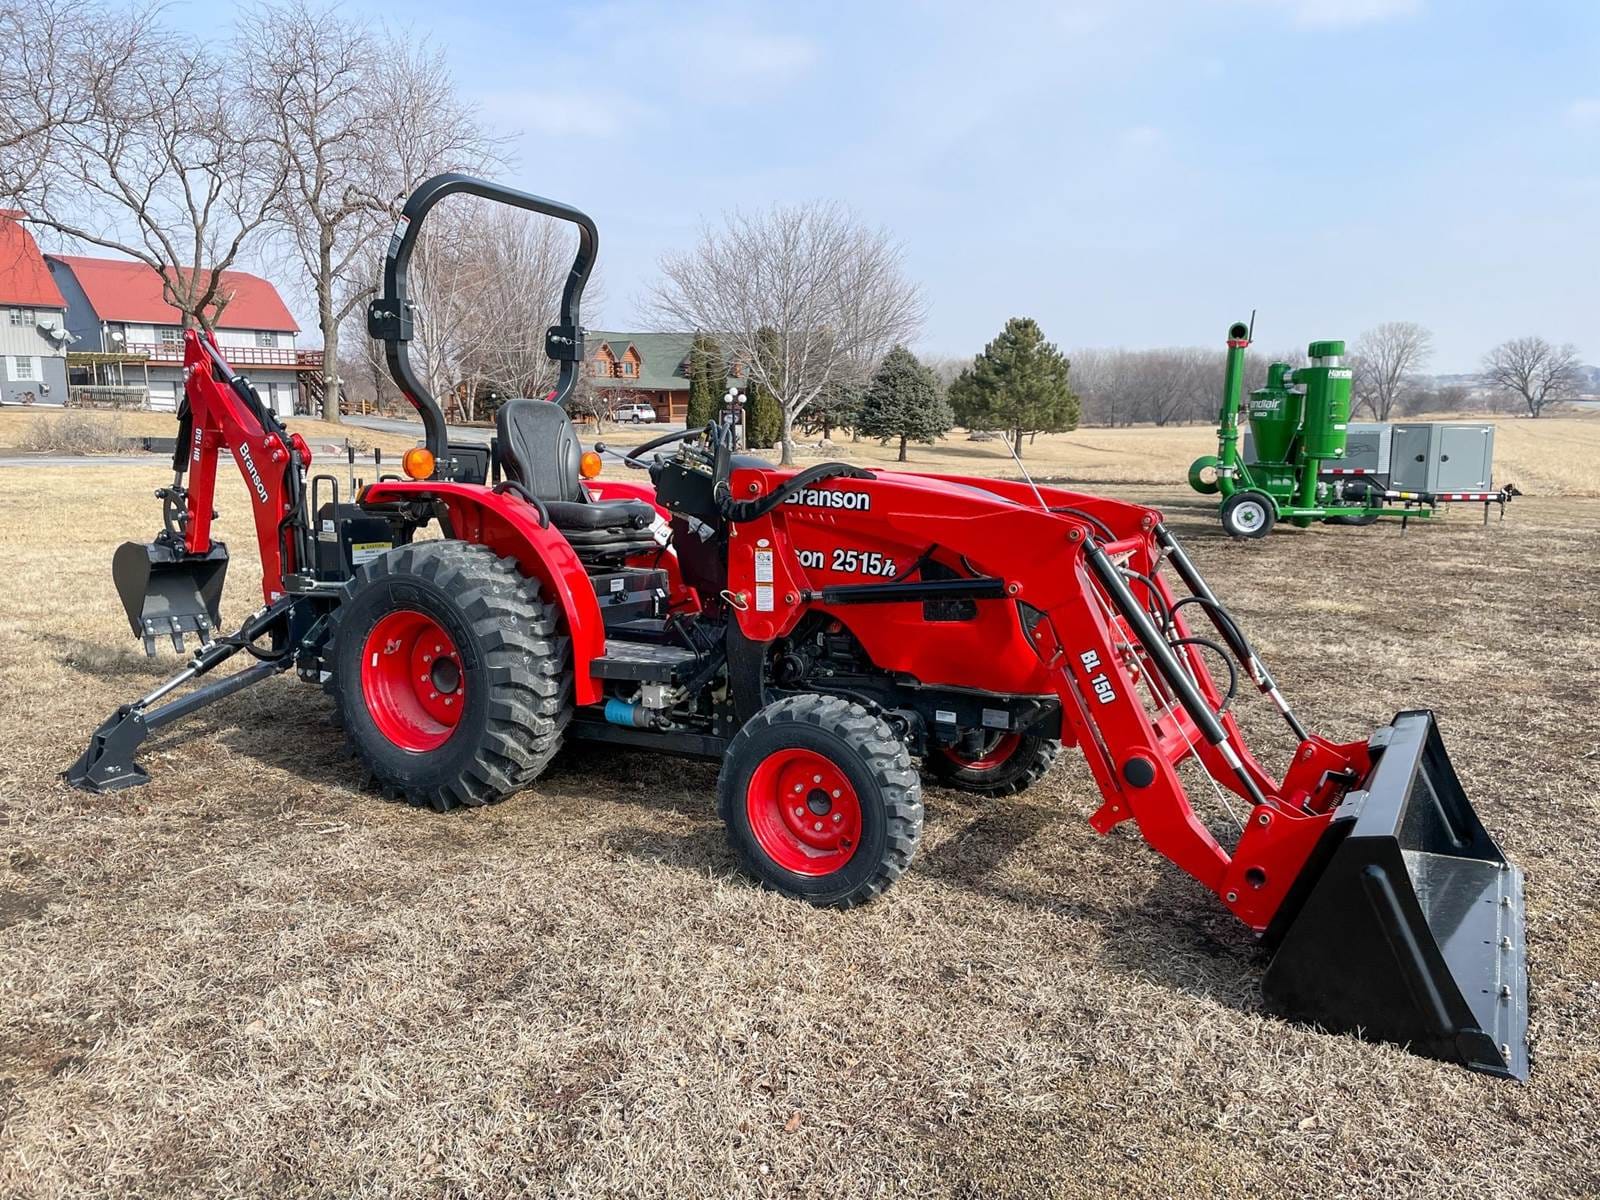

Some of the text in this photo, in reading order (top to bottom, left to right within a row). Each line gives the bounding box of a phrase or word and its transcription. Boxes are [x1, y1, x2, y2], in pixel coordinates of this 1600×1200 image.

[193, 447, 200, 461] BH
[240, 442, 268, 503] Branson
[832, 549, 896, 577] 2515h
[1080, 649, 1116, 704] BL 150
